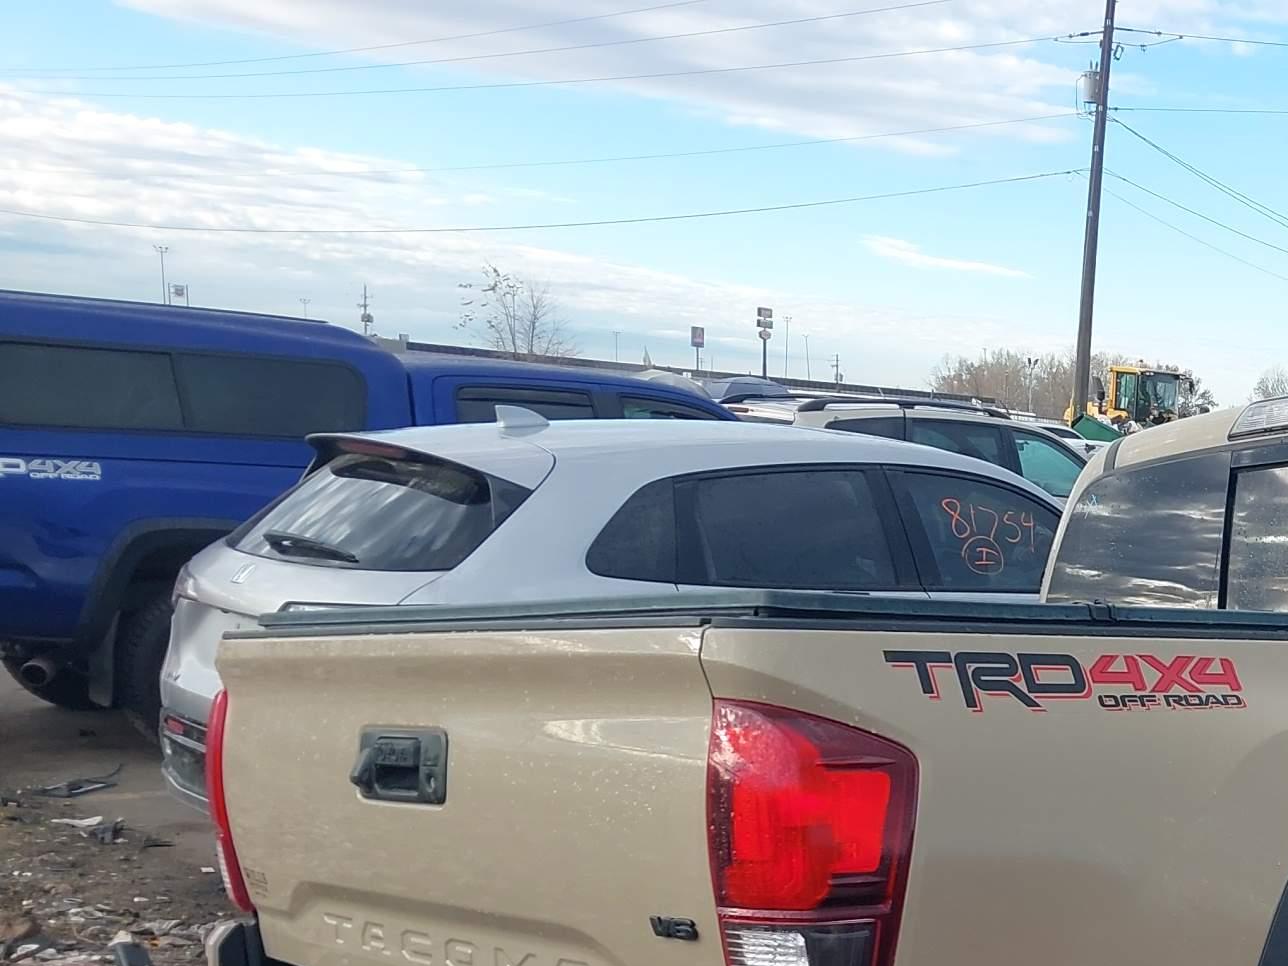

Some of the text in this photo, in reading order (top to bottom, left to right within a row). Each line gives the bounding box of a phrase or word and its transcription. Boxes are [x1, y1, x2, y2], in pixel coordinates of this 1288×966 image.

[883, 650, 1092, 713] TRD
[1097, 694, 1248, 712] OFF ROAD
[649, 916, 699, 941] V6
